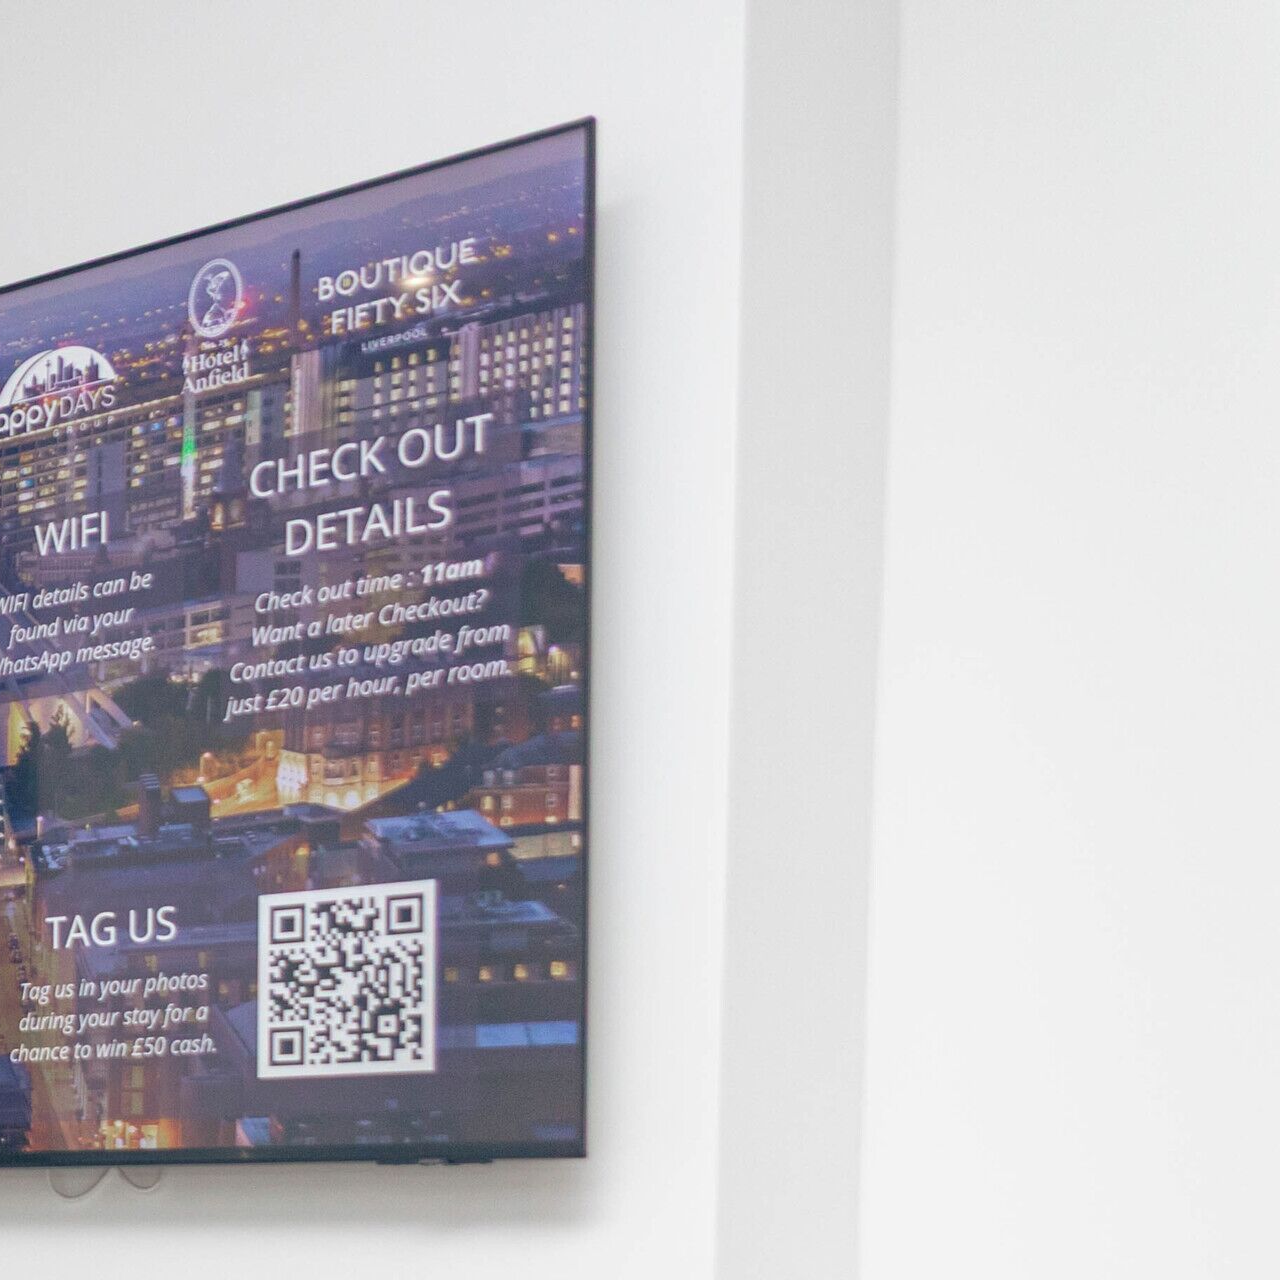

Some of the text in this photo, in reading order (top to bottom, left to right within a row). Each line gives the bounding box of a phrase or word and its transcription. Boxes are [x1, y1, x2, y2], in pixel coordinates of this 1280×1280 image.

[318, 237, 480, 301] BOUTIQUE
[331, 279, 462, 334] FIFTY SIX
[190, 344, 239, 373] Hotel
[361, 327, 428, 352] LIVERPOOL
[180, 360, 249, 394] Anfield
[52, 415, 114, 437] GROUP
[249, 413, 494, 500] CHECK OUT
[34, 510, 109, 556] WIFI
[285, 490, 453, 557] DETAILS
[32, 581, 89, 610] details
[93, 577, 125, 598] can
[129, 570, 153, 592] be
[255, 584, 313, 614] Check
[316, 579, 353, 603] out
[356, 571, 403, 596] time
[420, 558, 483, 585] 11am
[6, 607, 136, 650] found via your
[251, 588, 490, 647] Want a later Checkout?
[76, 635, 156, 660] message.
[229, 623, 511, 683] Contact us to upgrade from
[223, 658, 512, 723] just £20 per hour, per room.
[45, 905, 178, 951] TAG US
[20, 971, 209, 1005] Tag us in your photos
[18, 1003, 210, 1035] during your stay for a
[9, 1033, 218, 1064] chance to win £50 cash.
